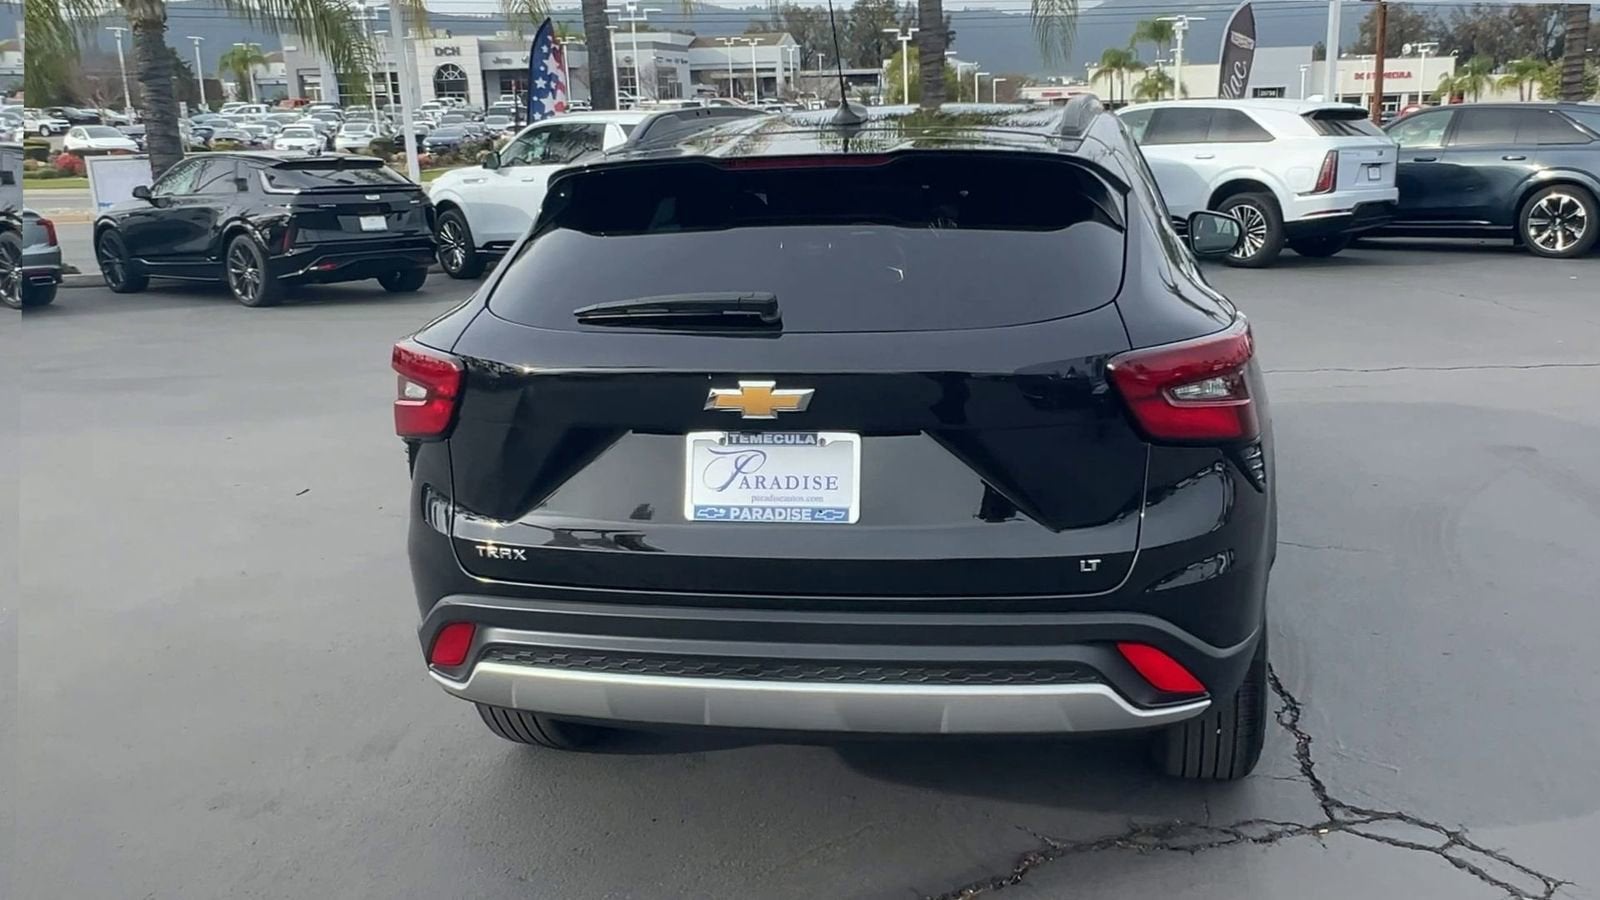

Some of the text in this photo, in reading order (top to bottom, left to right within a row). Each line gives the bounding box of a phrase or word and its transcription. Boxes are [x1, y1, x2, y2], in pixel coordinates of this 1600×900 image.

[434, 46, 461, 56] DCH
[1371, 71, 1412, 80] TMECULA
[729, 433, 816, 445] TEMECULA
[703, 447, 839, 493] PARADISE
[729, 508, 812, 521] PARADISE
[475, 545, 528, 561] TRAX
[1079, 558, 1102, 573] LT
